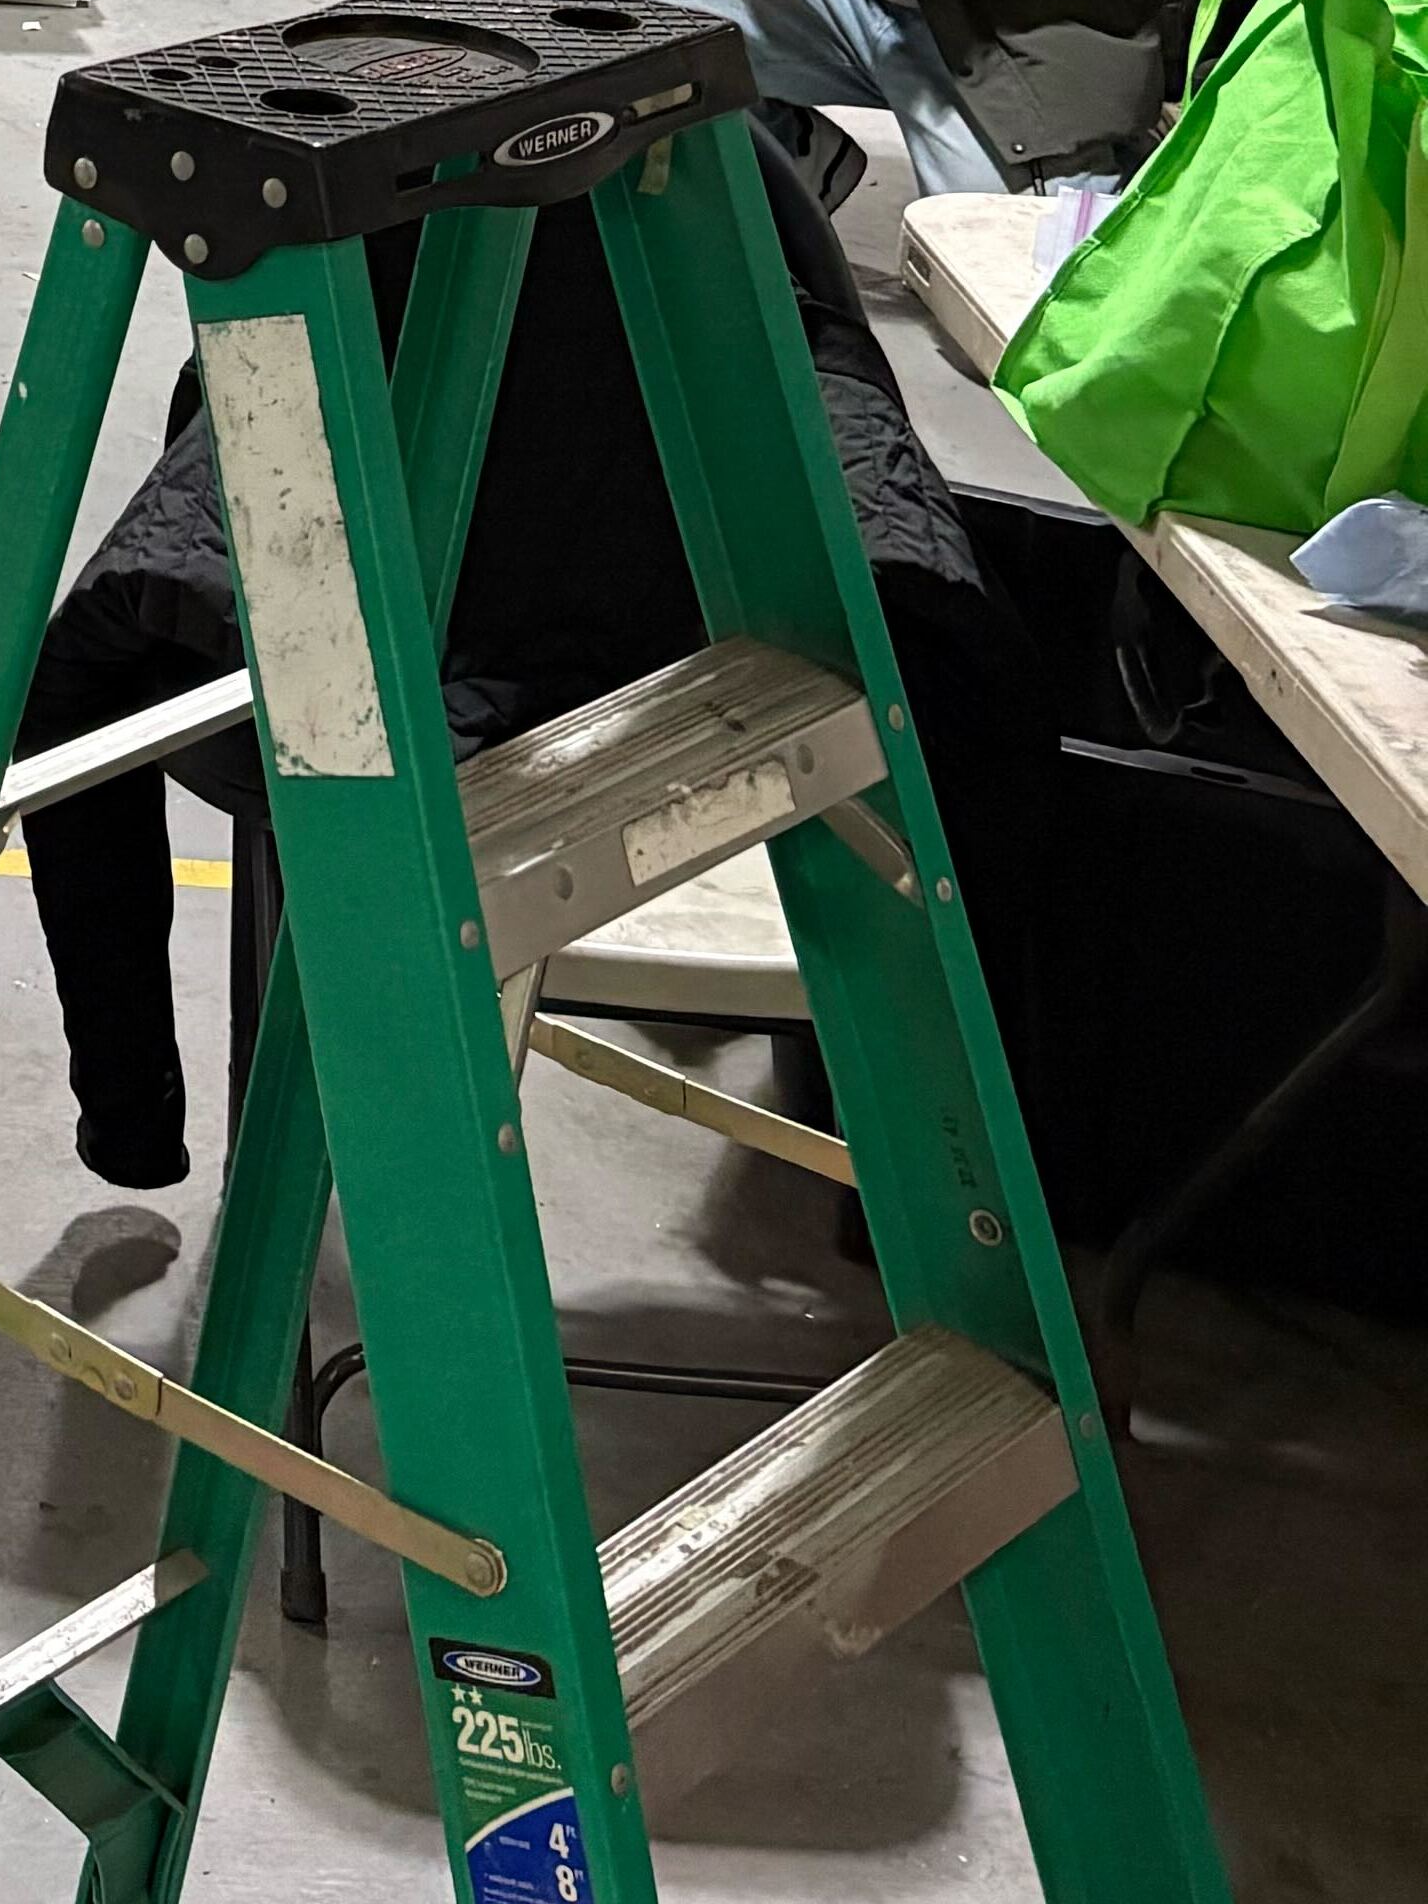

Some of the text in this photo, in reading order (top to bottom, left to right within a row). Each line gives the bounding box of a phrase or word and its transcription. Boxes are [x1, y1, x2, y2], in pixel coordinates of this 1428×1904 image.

[517, 119, 593, 158] WERNER
[463, 1657, 521, 1678] WERNER
[451, 1706, 563, 1771] 225 lbs.
[548, 1822, 570, 1860] 4
[554, 1864, 578, 1903] 8
